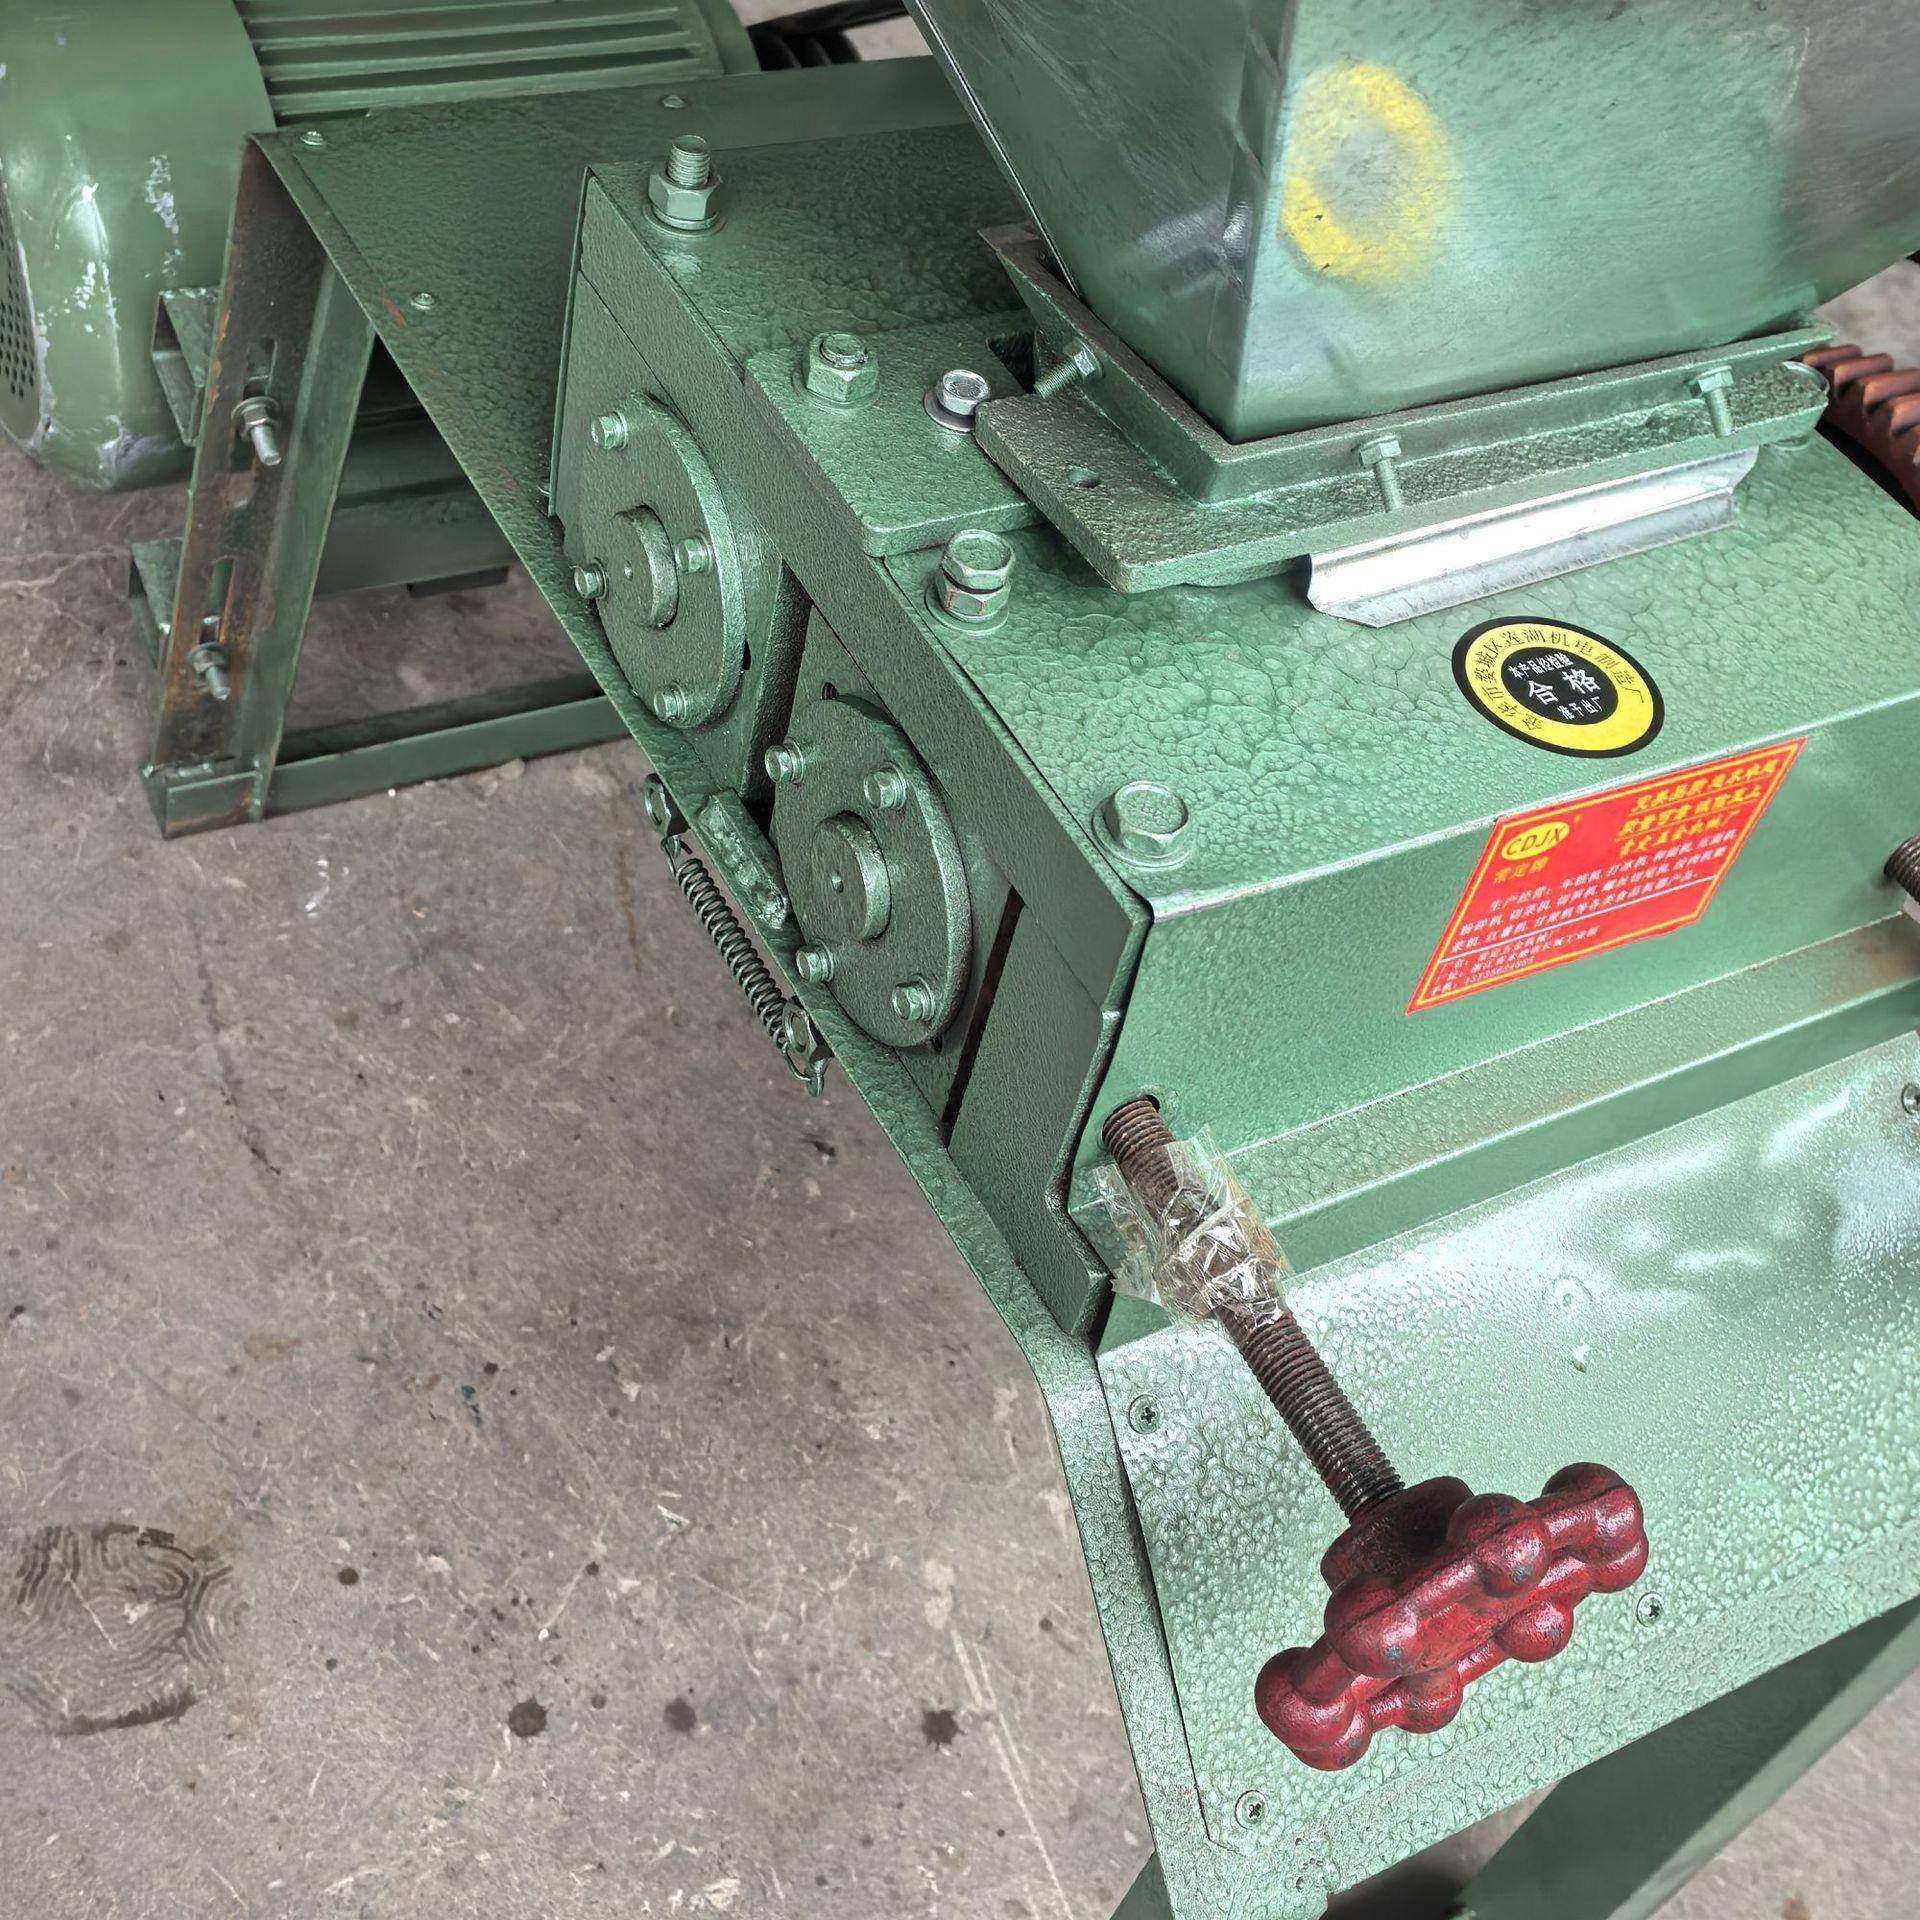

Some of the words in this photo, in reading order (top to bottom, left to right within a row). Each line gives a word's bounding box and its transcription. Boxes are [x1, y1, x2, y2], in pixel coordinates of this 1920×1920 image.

[1508, 652, 1574, 680] 本产品经检验
[1557, 696, 1605, 720] 准予出厂
[1506, 826, 1566, 856] CDJX
